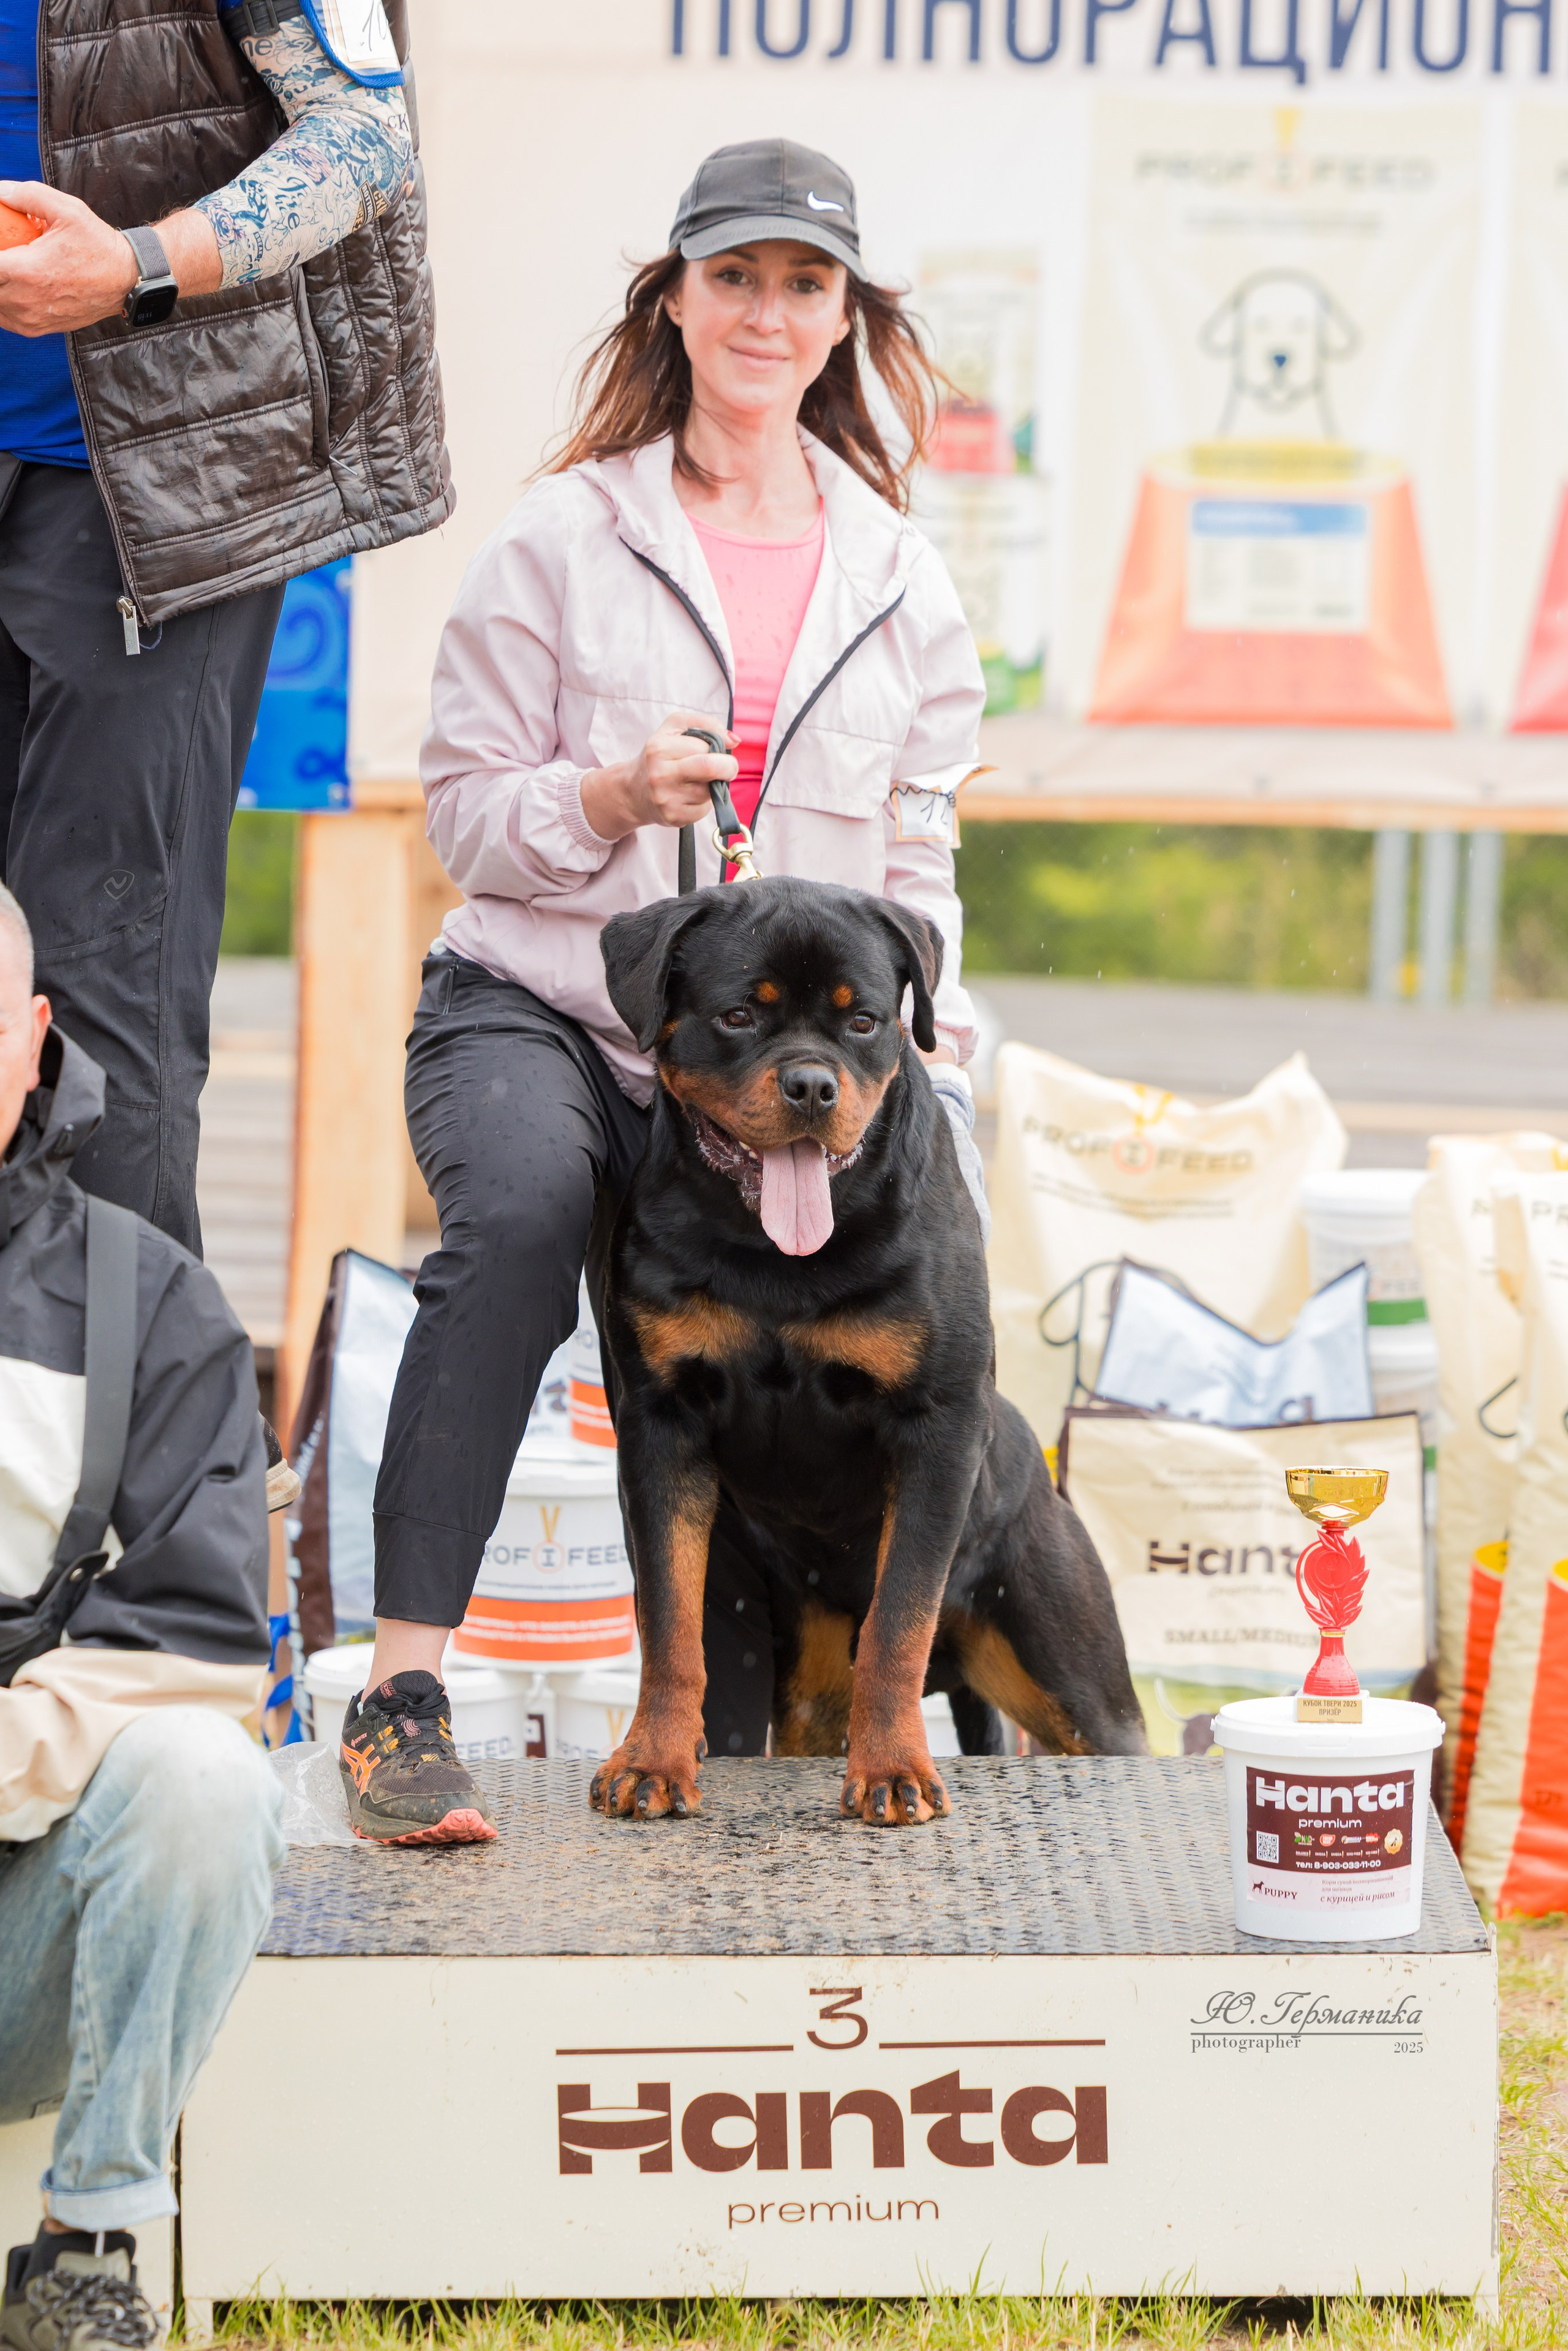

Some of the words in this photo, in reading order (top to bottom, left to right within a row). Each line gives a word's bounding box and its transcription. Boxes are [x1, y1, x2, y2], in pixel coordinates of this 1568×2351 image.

[1147, 1538, 1305, 1577] Hant
[1256, 1776, 1405, 1813] Hanta
[1298, 1817, 1362, 1828] premium
[1264, 1887, 1298, 1900] PUPPY
[1327, 1893, 1364, 1904] курицей
[1372, 1892, 1395, 1903] рисом
[805, 1985, 870, 2050] 3
[556, 2069, 1110, 2176] Hanta
[726, 2194, 941, 2231] premium
